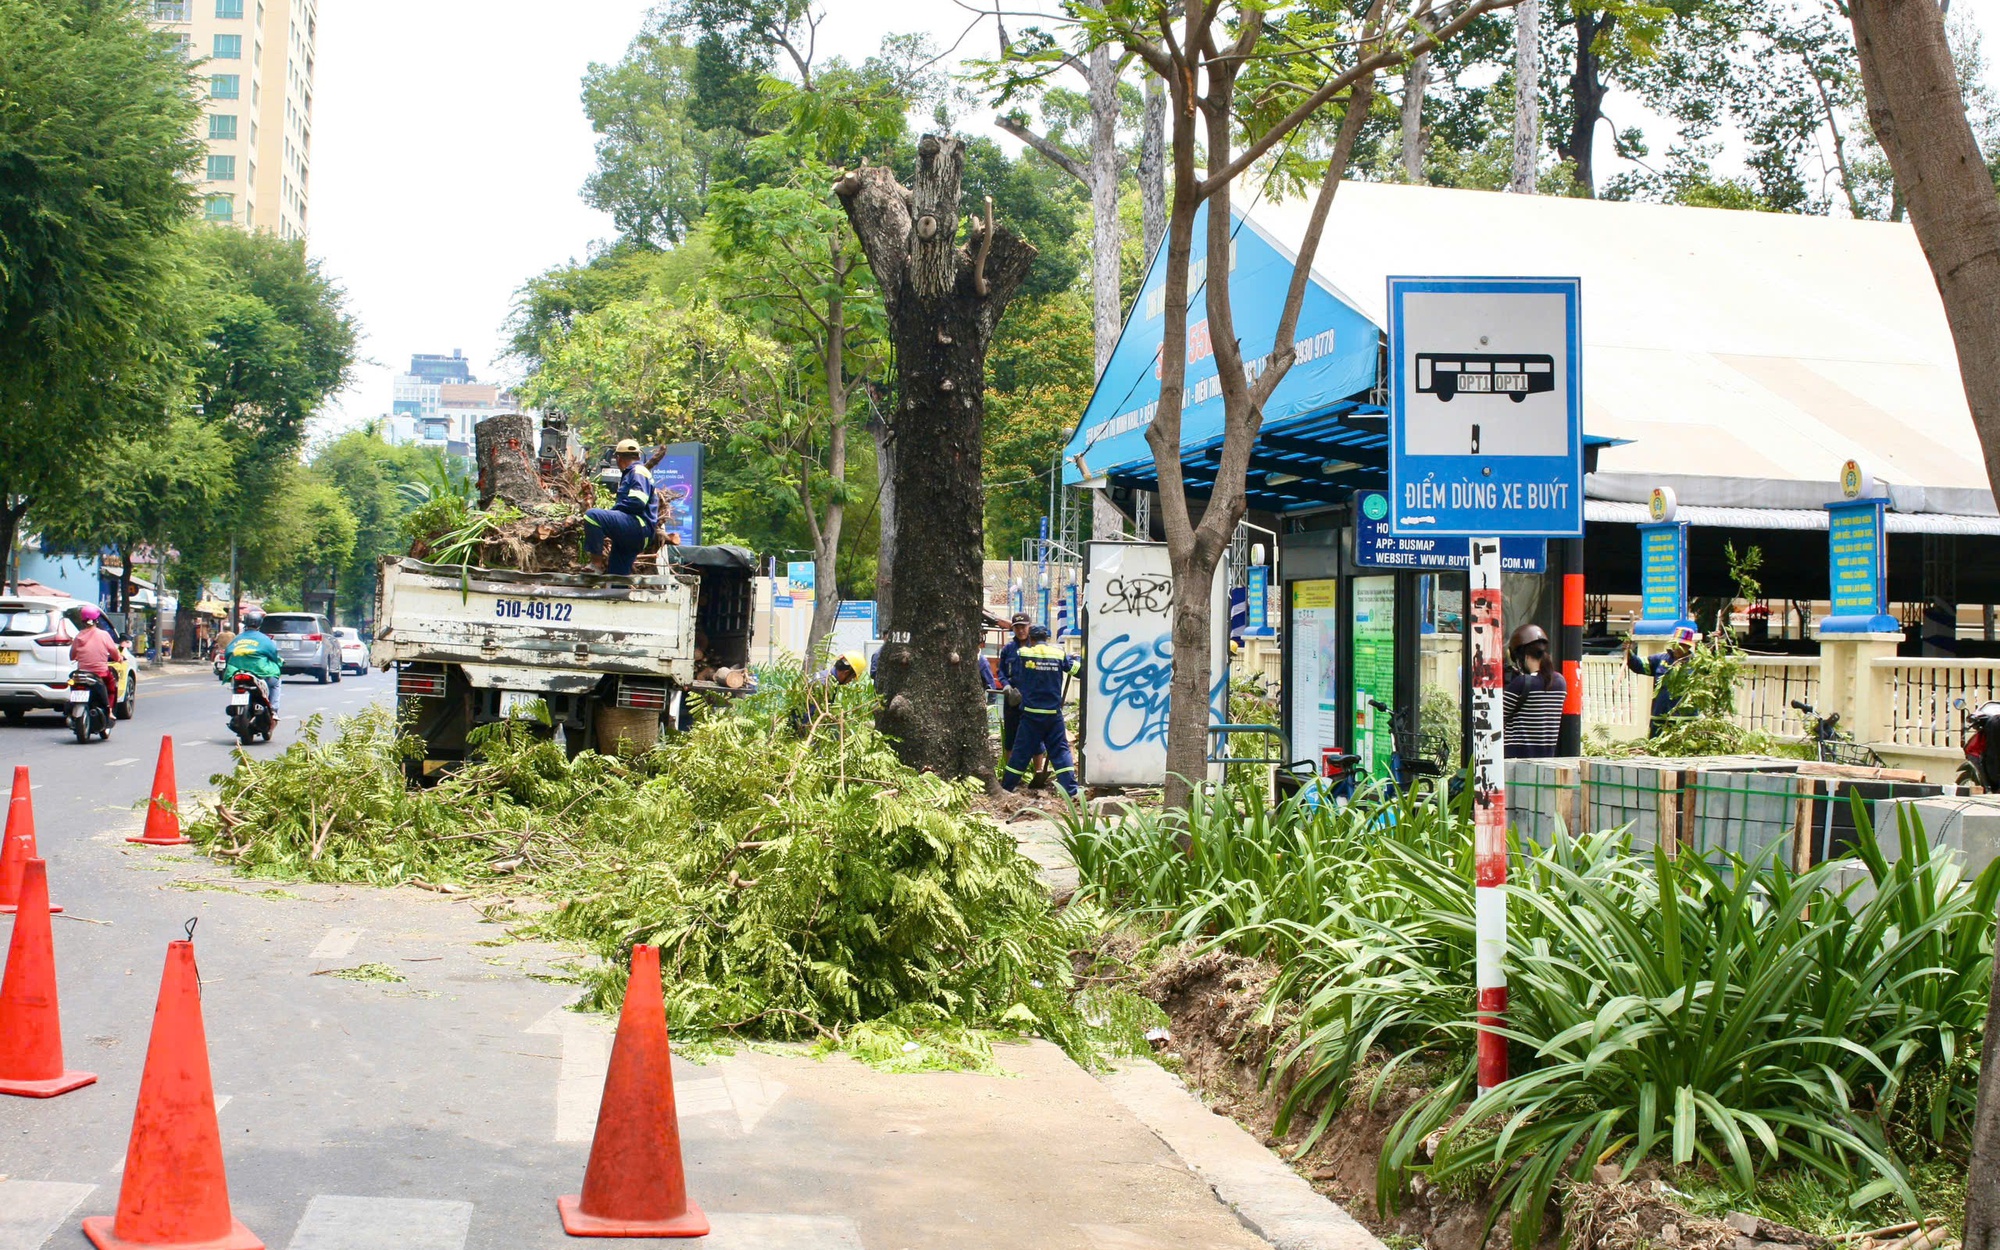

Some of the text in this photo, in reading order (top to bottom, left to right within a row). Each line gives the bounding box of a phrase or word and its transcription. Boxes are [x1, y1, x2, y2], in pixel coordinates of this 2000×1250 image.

[1314, 328, 1334, 359] 9778
[1405, 472, 1568, 509] ĐIỂM DỪNG XE BUÝT
[1376, 522, 1389, 534] HO
[1375, 538, 1435, 551] APP: BUSMAP
[1375, 552, 1417, 565] WEBSITE:
